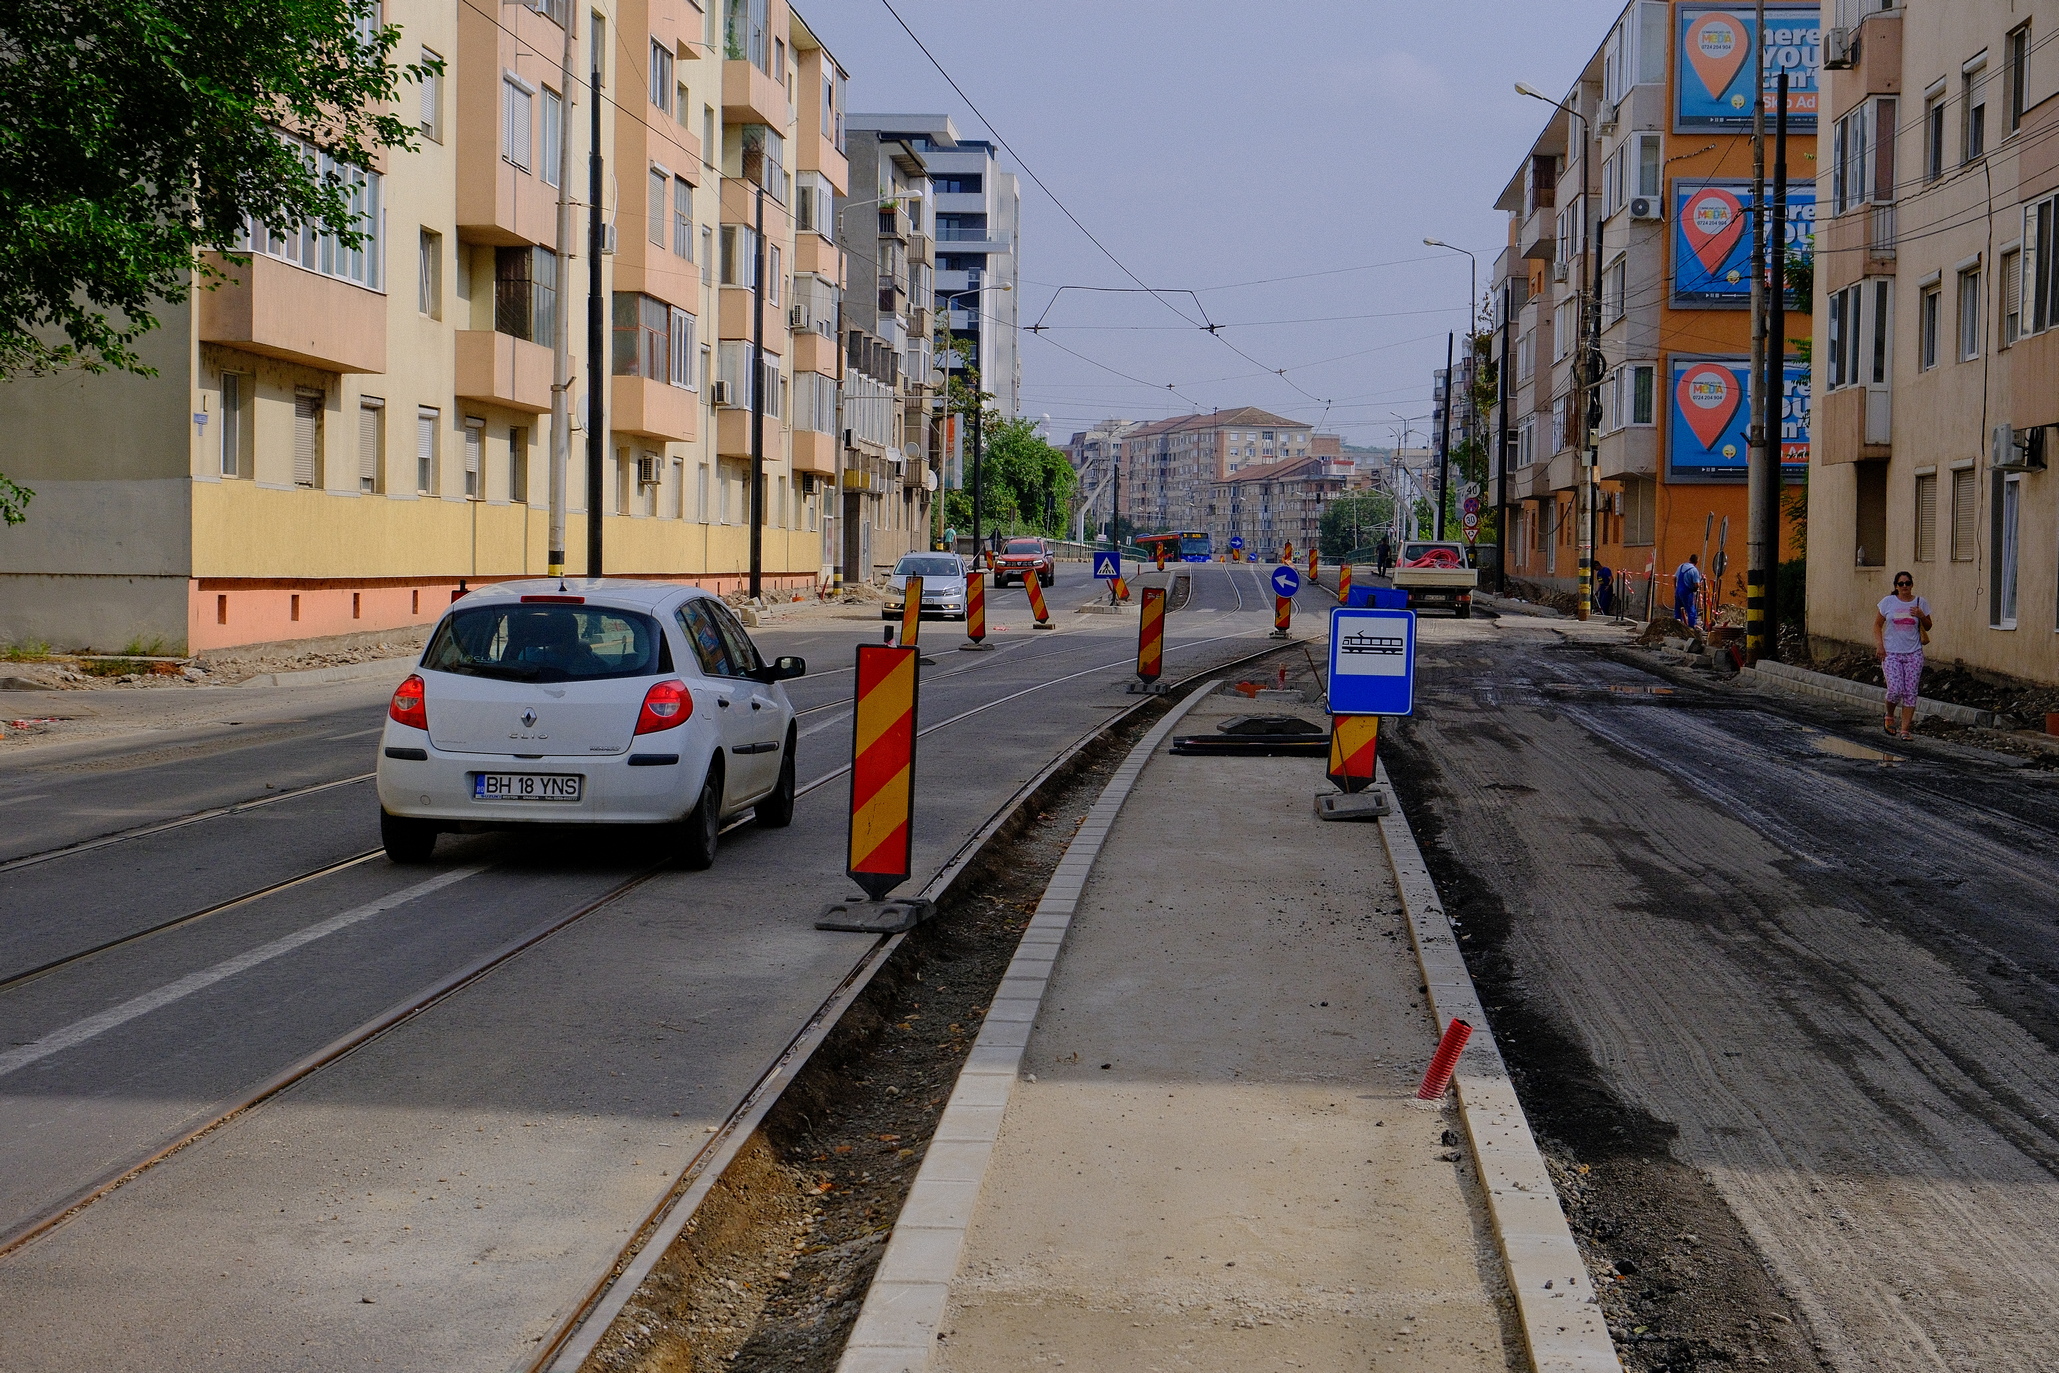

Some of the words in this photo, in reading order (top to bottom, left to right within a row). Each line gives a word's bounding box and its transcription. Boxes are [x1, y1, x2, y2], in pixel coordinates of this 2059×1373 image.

[1795, 96, 1816, 109] Ad
[1466, 485, 1478, 495] 40
[1465, 515, 1476, 525] 30
[476, 785, 485, 793] RO
[486, 776, 511, 794] BH
[518, 777, 534, 795] 18
[540, 777, 577, 795] YNS
